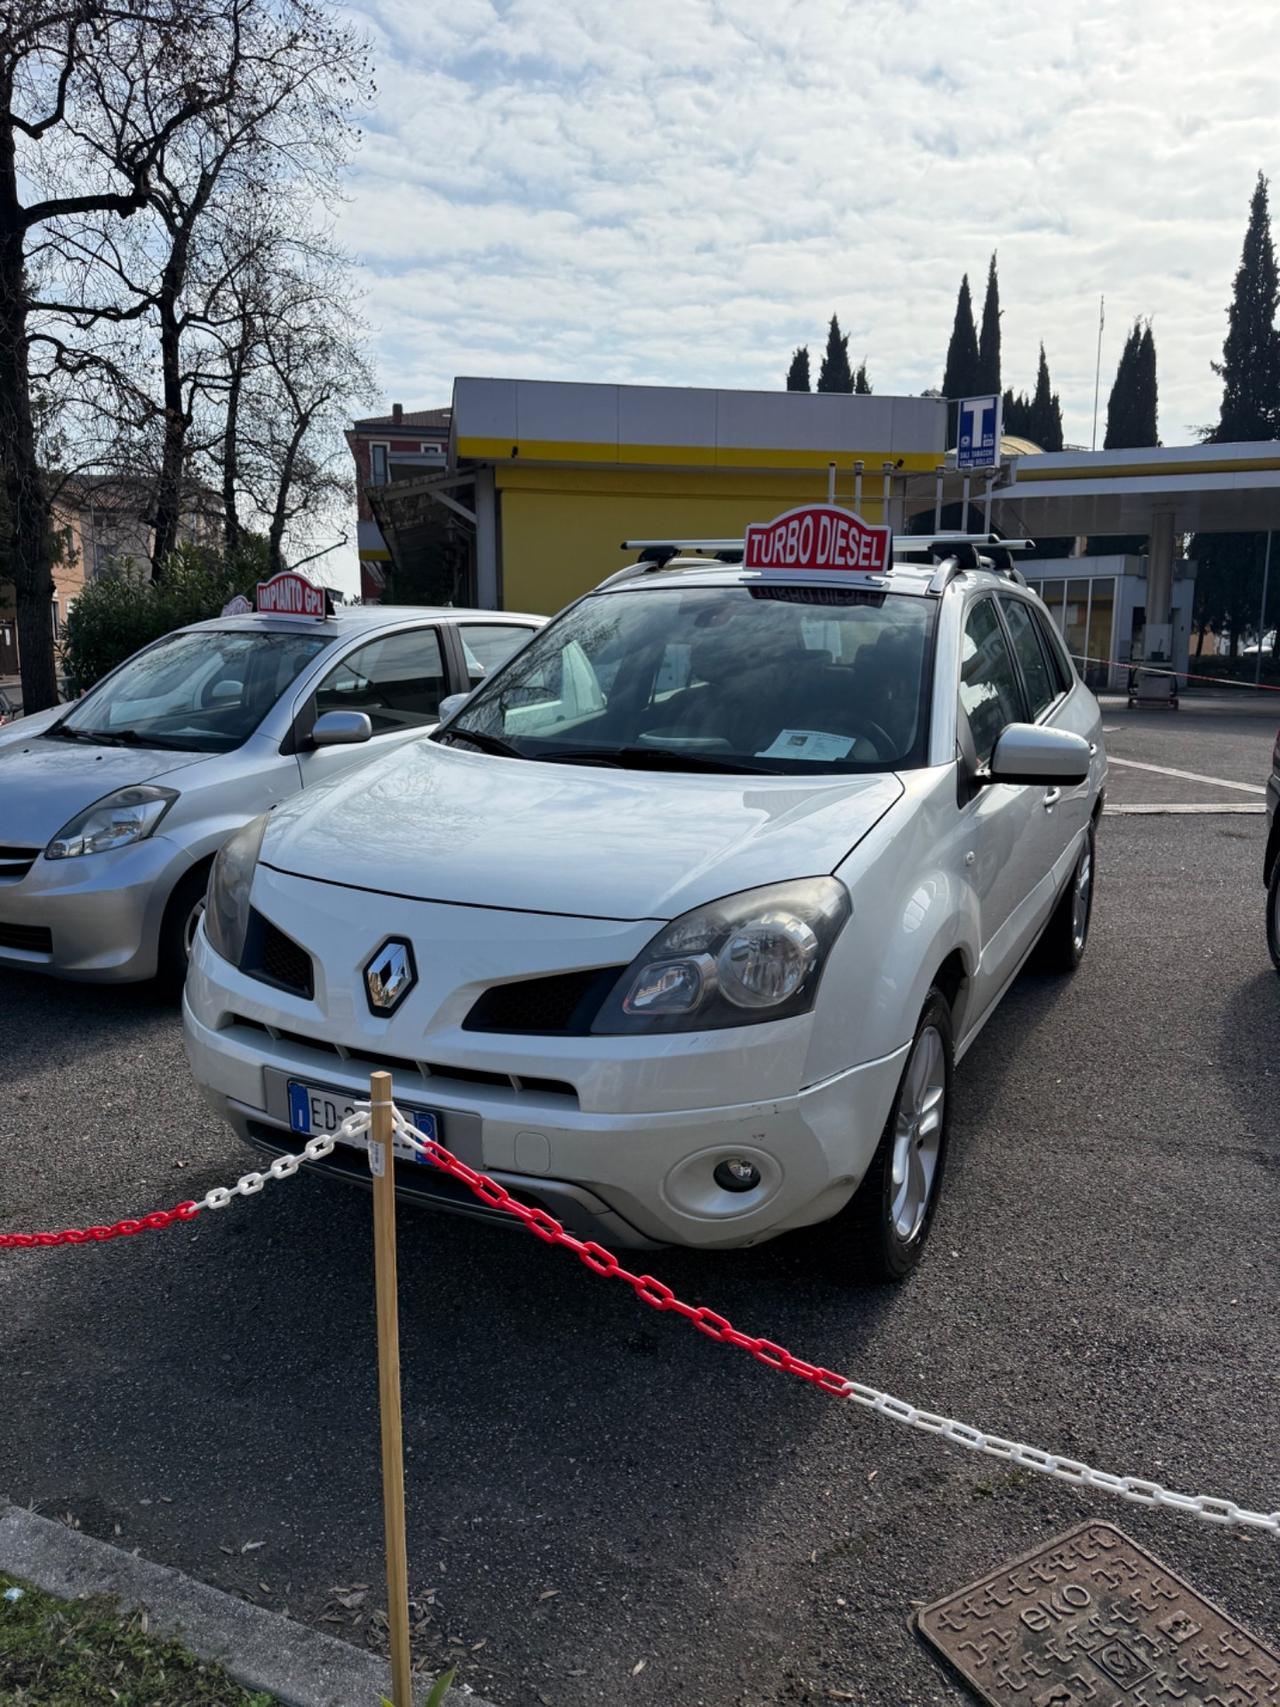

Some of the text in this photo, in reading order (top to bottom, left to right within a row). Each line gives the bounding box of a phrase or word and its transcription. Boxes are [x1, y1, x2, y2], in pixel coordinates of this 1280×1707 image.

[963, 398, 995, 448] T
[971, 449, 993, 458] TABACCHI
[751, 515, 881, 567] TURBO DIESEL
[259, 577, 303, 612] IMPIANTO
[304, 586, 322, 614] GPL
